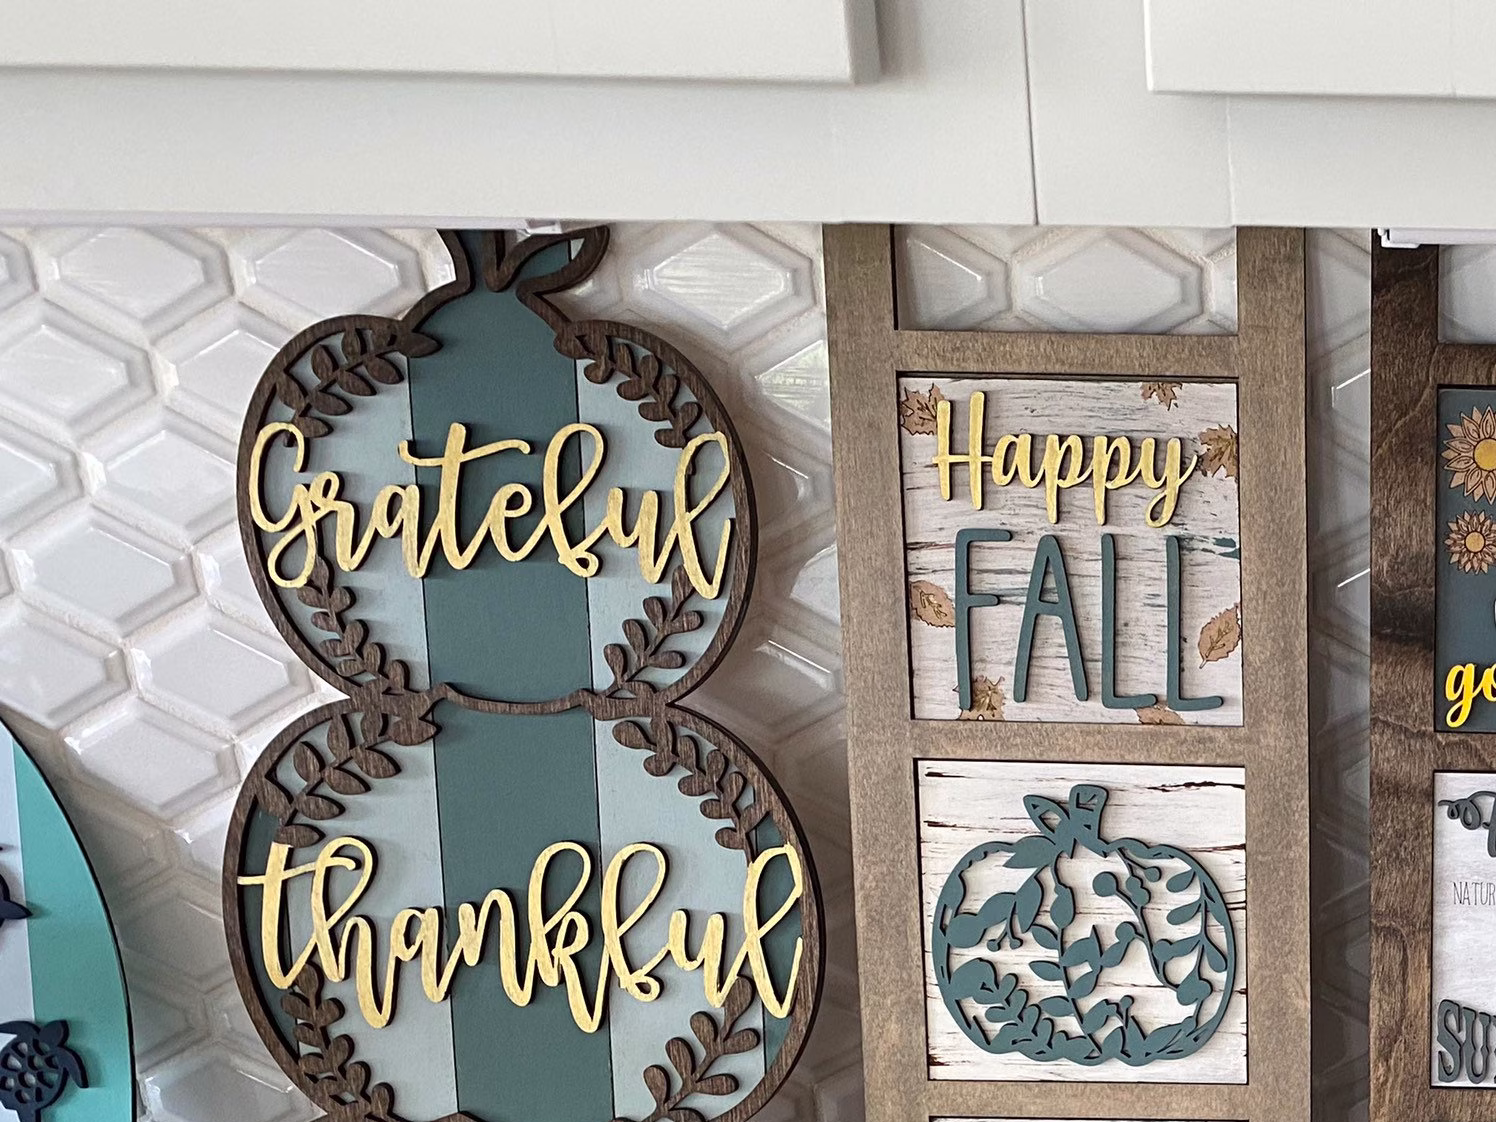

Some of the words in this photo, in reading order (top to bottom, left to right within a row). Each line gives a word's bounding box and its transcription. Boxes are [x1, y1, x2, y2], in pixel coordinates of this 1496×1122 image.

[249, 421, 731, 599] Grateful
[932, 391, 1198, 527] Happy
[954, 528, 1224, 711] FALL
[237, 837, 803, 1033] thankful
